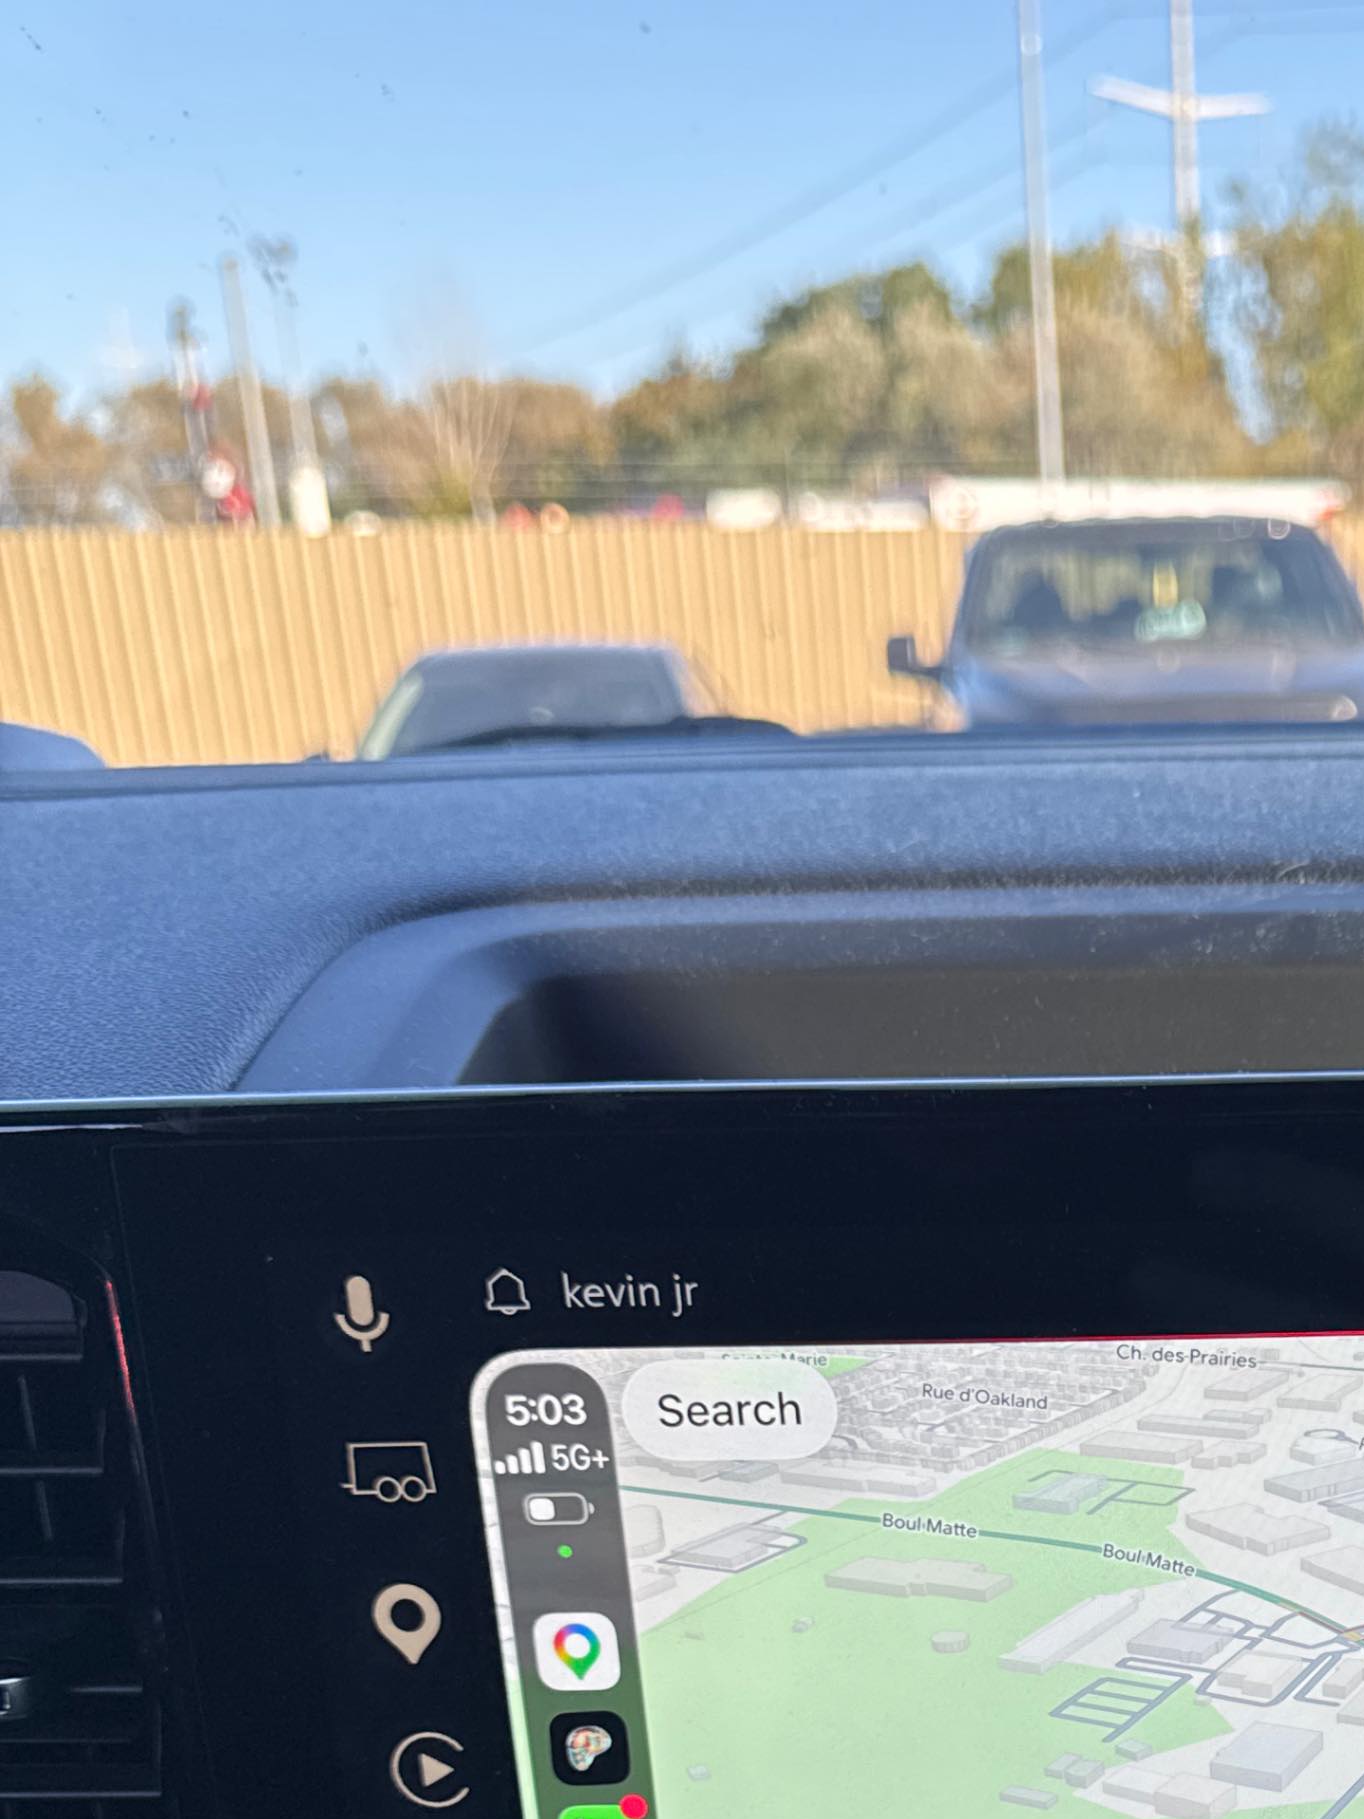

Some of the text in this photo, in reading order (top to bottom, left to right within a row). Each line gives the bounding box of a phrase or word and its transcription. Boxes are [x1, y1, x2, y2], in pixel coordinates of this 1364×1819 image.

[560, 1269, 699, 1318] kevin jr
[1116, 1343, 1257, 1369] Ch. des Prairies
[505, 1393, 588, 1427] 5:03
[658, 1391, 802, 1428] Search
[922, 1383, 1048, 1410] Rue d'Oakland
[552, 1444, 610, 1471] 5G+
[926, 1517, 978, 1539] Matte
[1145, 1552, 1195, 1577] Matte
